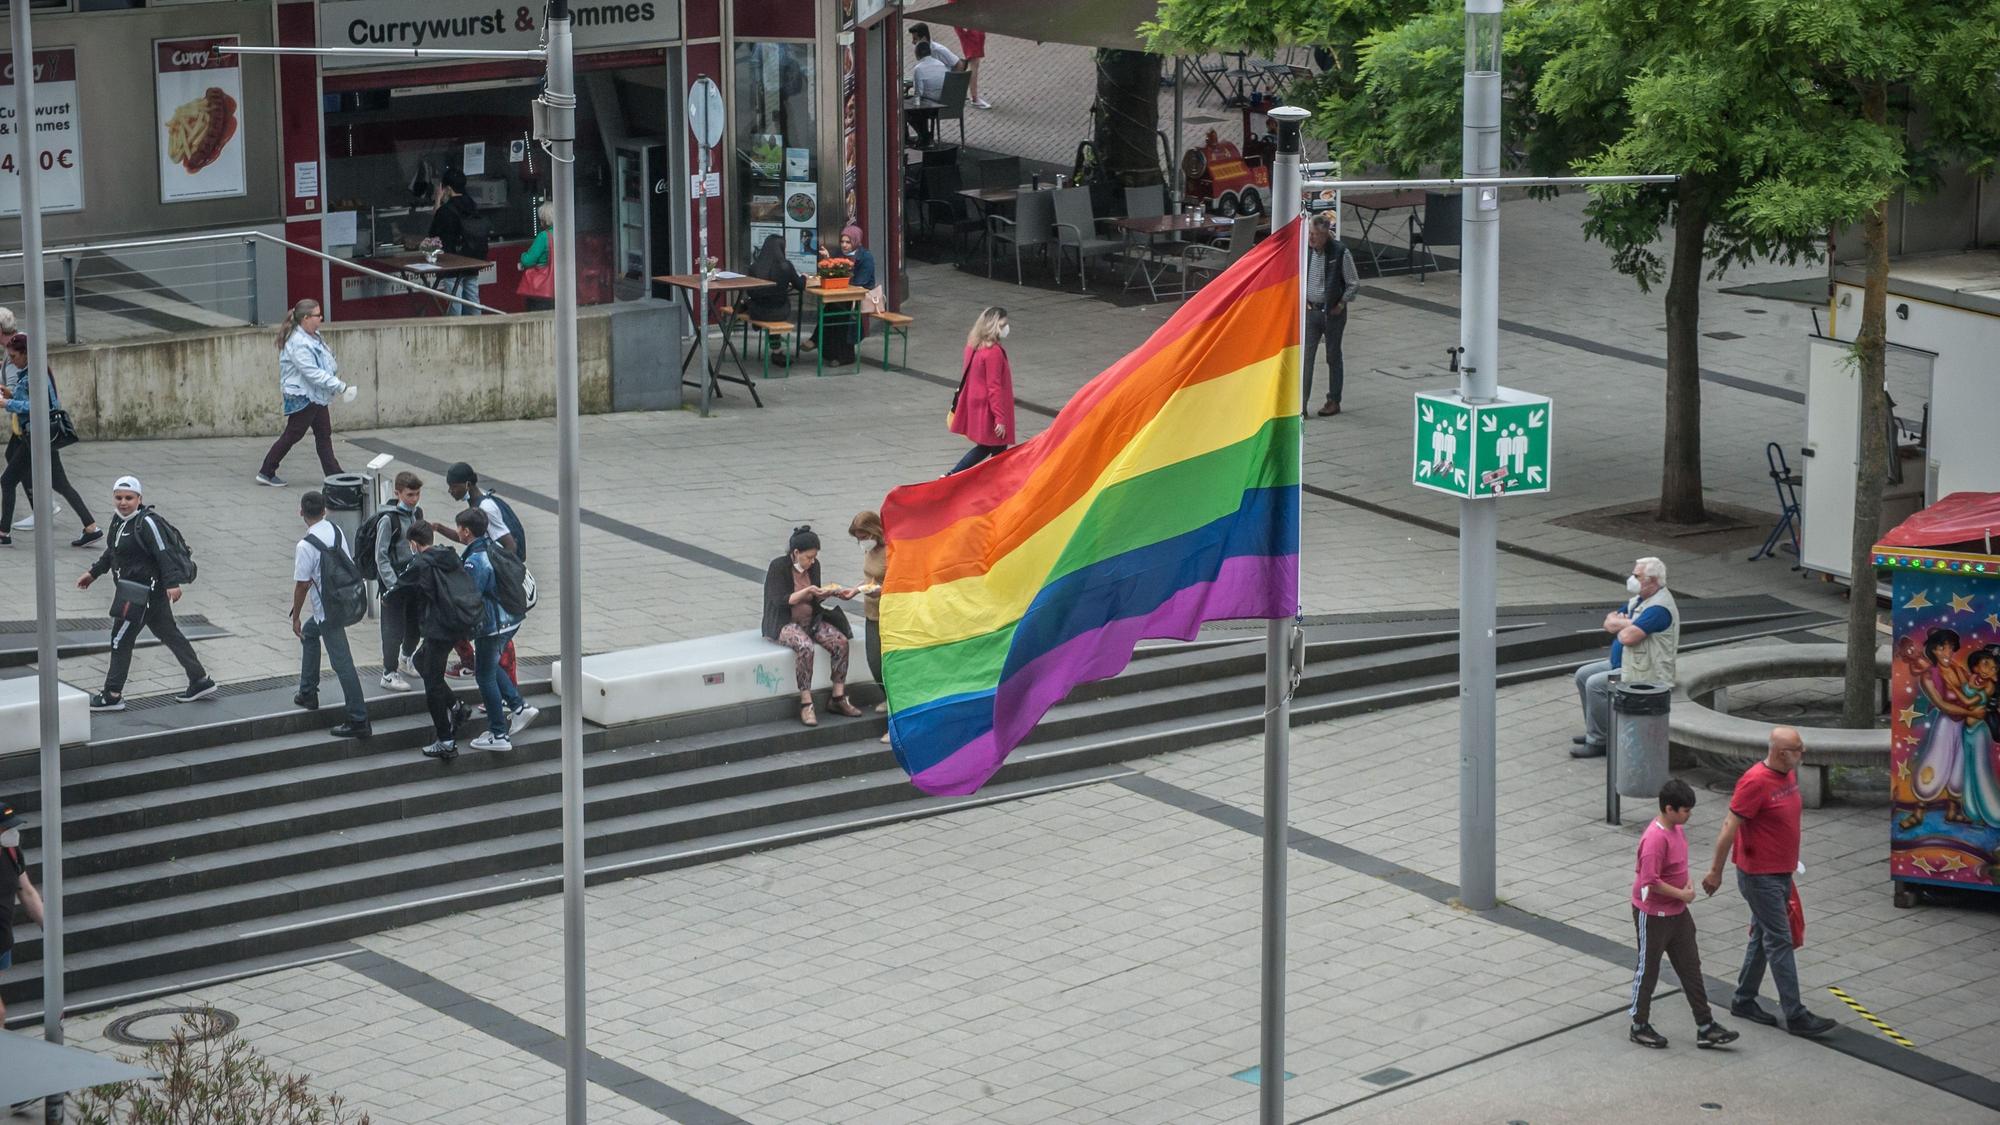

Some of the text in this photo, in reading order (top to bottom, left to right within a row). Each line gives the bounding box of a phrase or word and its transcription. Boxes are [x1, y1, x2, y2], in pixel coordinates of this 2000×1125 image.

[348, 2, 655, 46] Currywurst & mmes
[172, 50, 210, 69] Curry
[0, 102, 70, 118] Cuwurst
[0, 123, 9, 135] &
